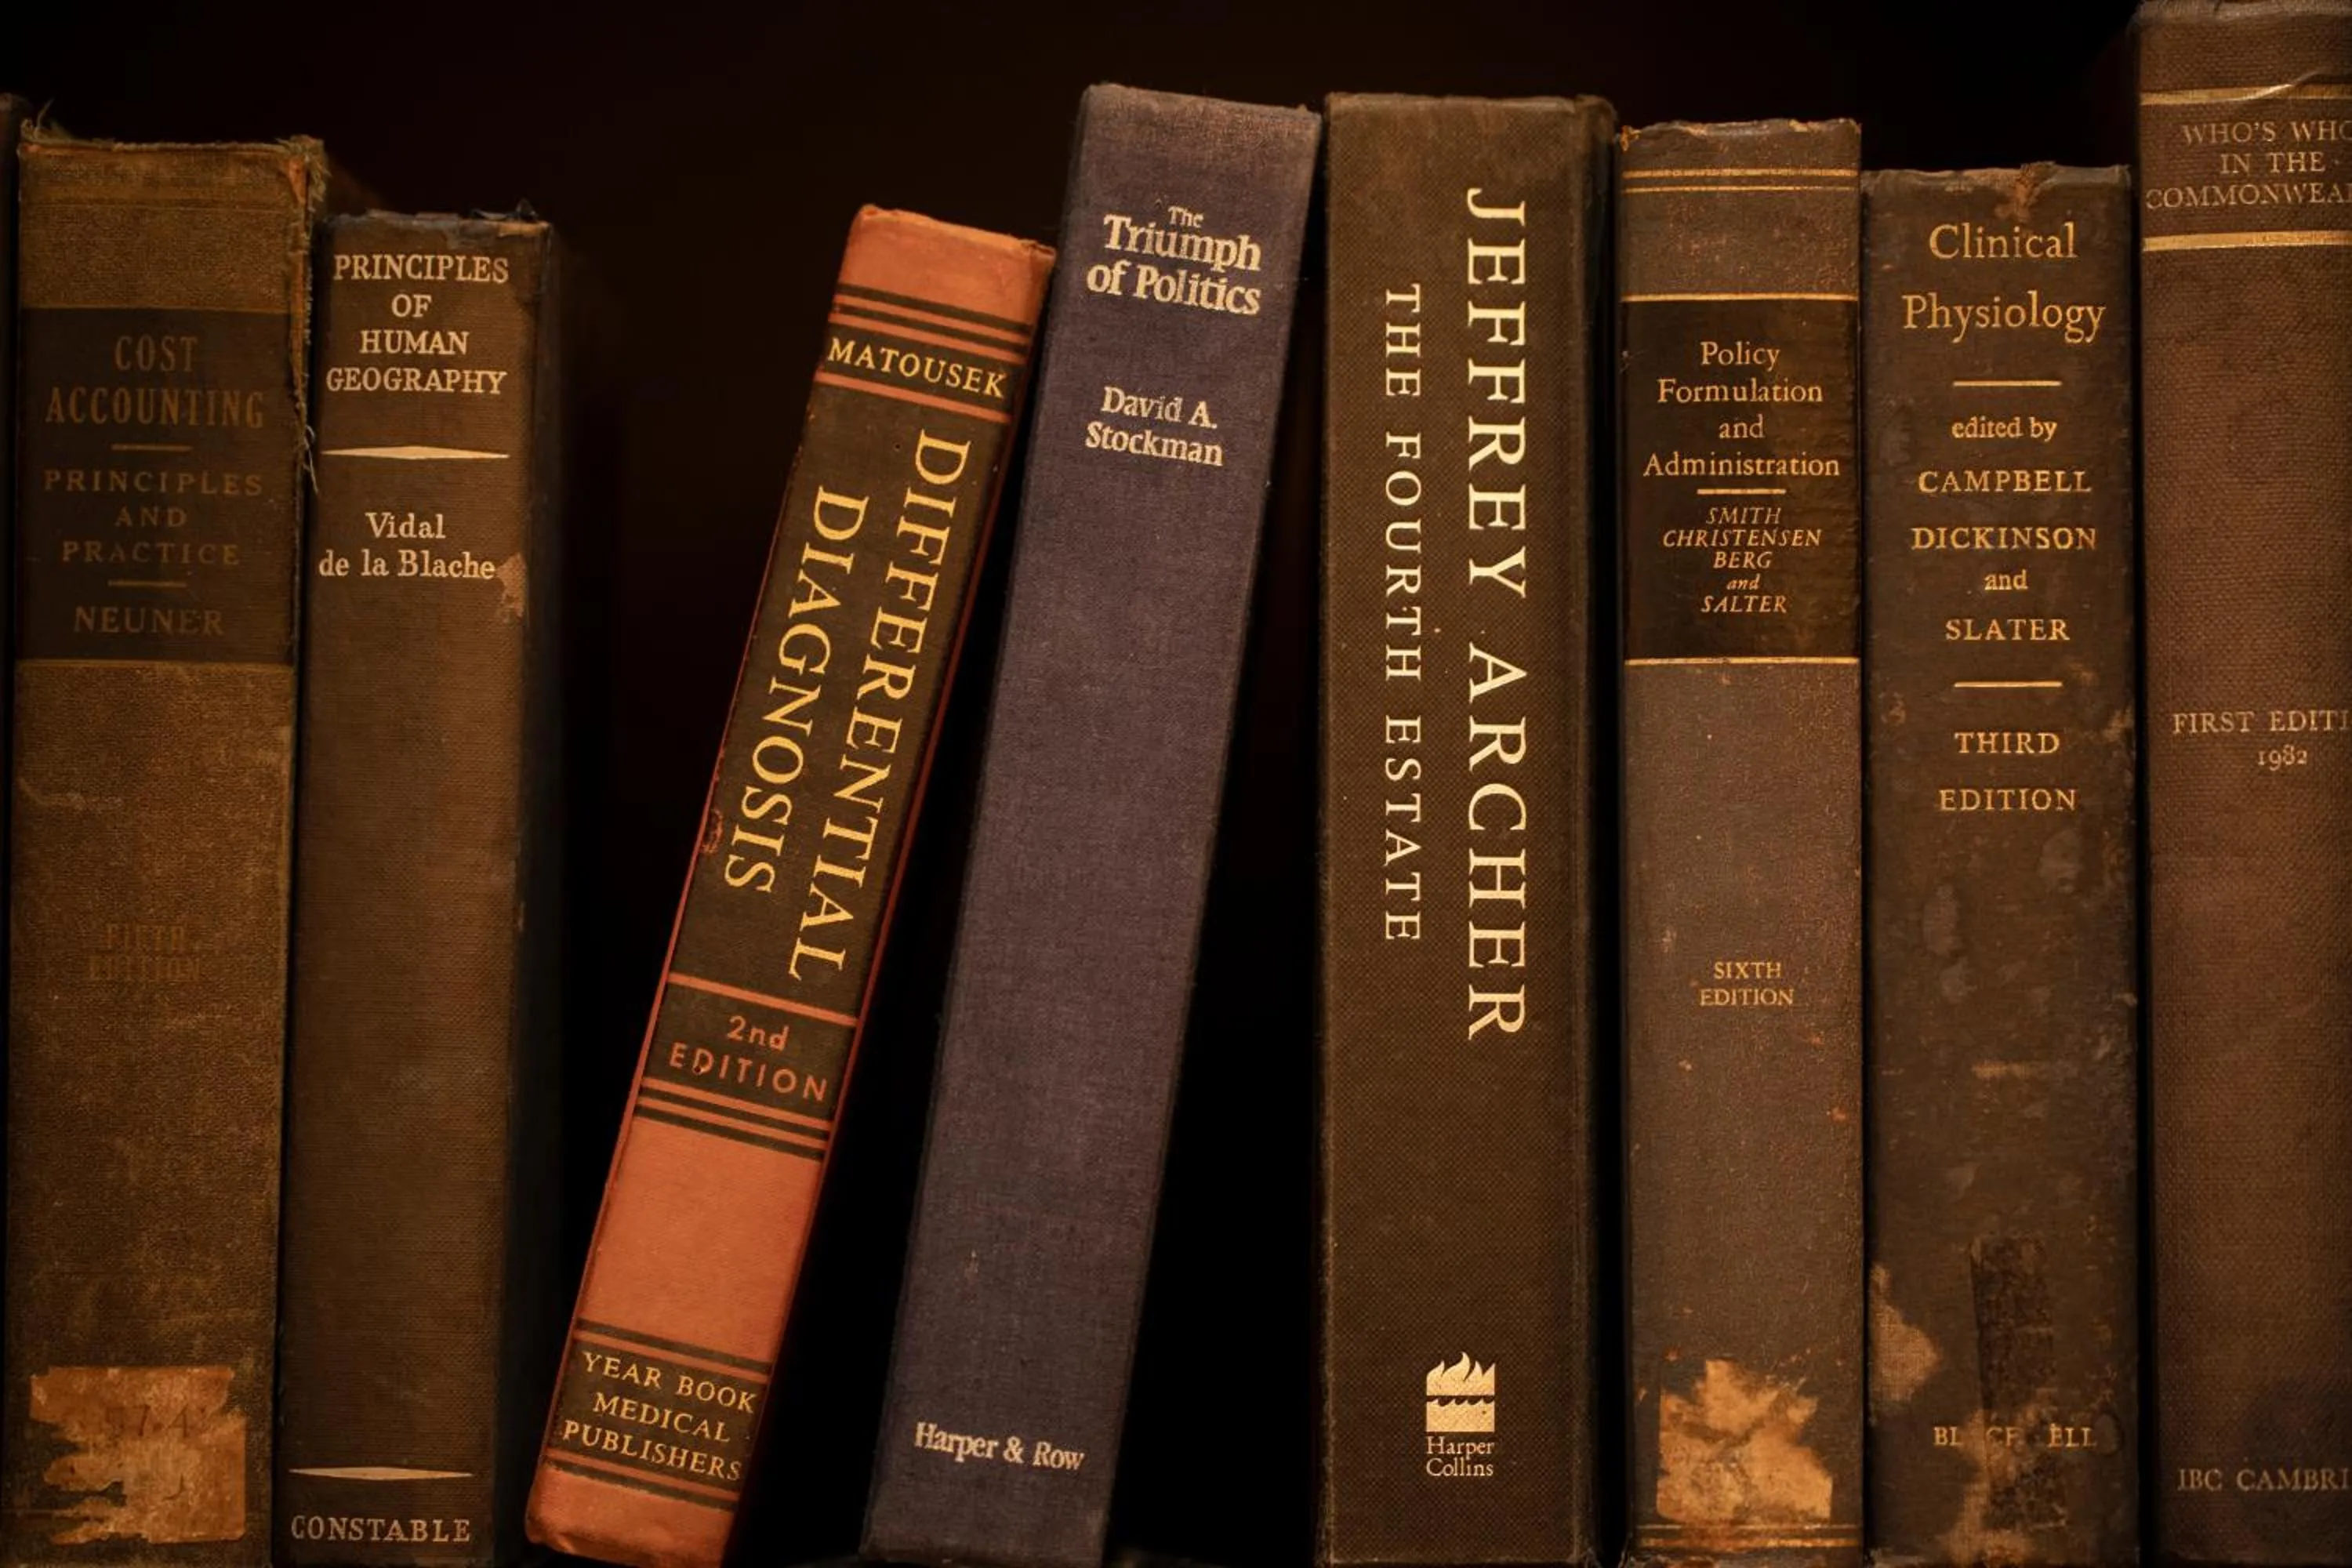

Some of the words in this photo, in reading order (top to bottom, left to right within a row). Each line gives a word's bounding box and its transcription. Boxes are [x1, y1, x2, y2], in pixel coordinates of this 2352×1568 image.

[2182, 121, 2277, 146] WHO'S
[2220, 153, 2252, 176] IN
[2270, 151, 2326, 173] THE
[1167, 205, 1204, 228] The
[1103, 213, 1261, 273] Triumph
[1929, 220, 2080, 260] Clinical
[332, 254, 510, 284] PRINCIPLES
[1086, 259, 1131, 296] of
[1132, 264, 1261, 315] Politics
[391, 293, 432, 318] OF
[1901, 289, 2107, 343] Physiology
[359, 329, 470, 355] HUMAN
[1385, 283, 1421, 396] THE
[114, 336, 198, 373] COST
[826, 336, 1009, 400] MATOUSEK
[1700, 339, 1780, 372] Policy
[325, 367, 507, 394] GEOGRAPHY
[1466, 187, 1526, 598] JEFFREY
[1656, 377, 1824, 404] Formulation
[45, 387, 264, 429] ACCOUNTING
[1100, 386, 1183, 423] David
[1188, 401, 1218, 429] A.
[1719, 414, 1765, 439] and
[1951, 416, 2023, 439] edited
[2028, 416, 2058, 442] by
[1085, 421, 1224, 466] Stockman
[1642, 451, 1840, 477] Administration
[42, 469, 263, 495] PRINCIPLES
[1918, 470, 2092, 494] CAMPBELL
[114, 506, 187, 528] AND
[365, 512, 446, 539] Vidal
[1705, 506, 1782, 524] SMITH
[1662, 528, 1823, 548] CHRISTENSEN
[1911, 526, 2098, 551] DICKINSON
[61, 539, 241, 565] PRACTICE
[319, 550, 349, 576] de
[361, 550, 389, 576] la
[397, 550, 495, 579] Blache
[1385, 430, 1421, 681] FOURTH
[1712, 550, 1773, 569] BERG
[1726, 574, 1761, 590] and
[1984, 568, 2029, 591] and
[1700, 594, 1788, 615] SALTER
[74, 606, 226, 635] NEUNER
[1945, 619, 2071, 641] SLATER
[723, 485, 869, 894] DIAGNOSIS
[788, 429, 972, 982] DIFFERENTIAL
[2172, 711, 2255, 735] FIRST
[1954, 731, 2060, 754] THIRD
[2258, 744, 2308, 771] 1982
[1938, 788, 2078, 811] EDITION
[1385, 715, 1421, 940] ESTATE
[1468, 641, 1528, 1040] ARCHER
[1714, 960, 1782, 979] SIXTH
[1700, 988, 1795, 1007] EDITION
[726, 1014, 789, 1051] 2nd
[669, 1041, 828, 1102] EDITION
[582, 1350, 662, 1390] YEAR
[674, 1375, 757, 1414] BOOK
[592, 1392, 731, 1443] MEDICAL
[562, 1419, 742, 1482] PUBLISHERS
[914, 1421, 1000, 1463] Harper
[1003, 1436, 1025, 1464] &
[1032, 1440, 1086, 1470] Row
[1425, 1436, 1495, 1460] Harper
[1425, 1457, 1494, 1477] Collins
[2177, 1468, 2223, 1491] IBC
[291, 1515, 471, 1543] CONSTABLE
